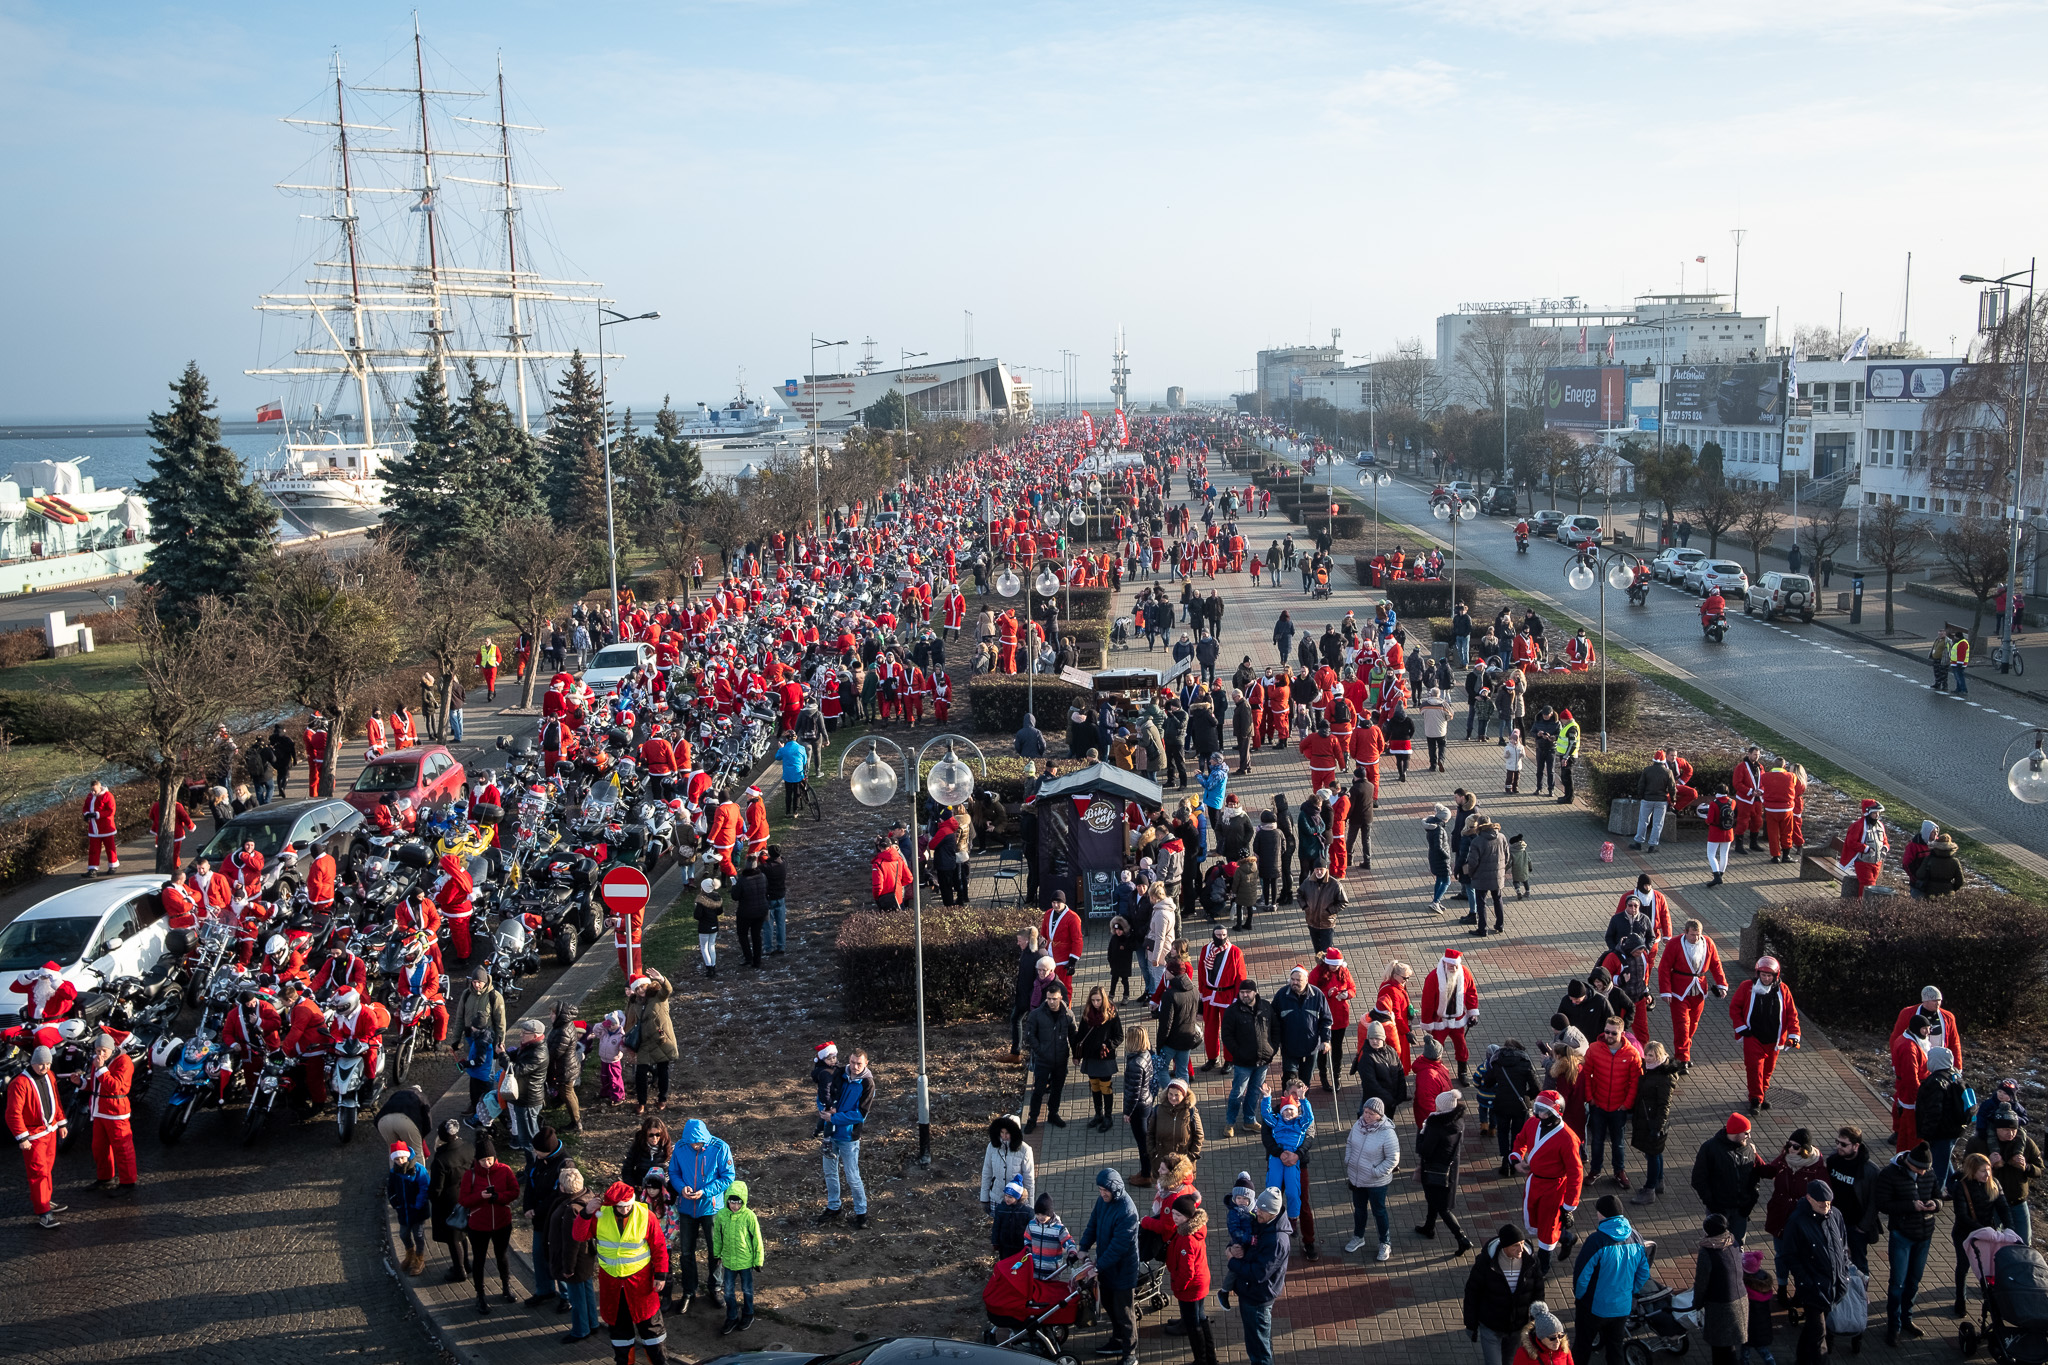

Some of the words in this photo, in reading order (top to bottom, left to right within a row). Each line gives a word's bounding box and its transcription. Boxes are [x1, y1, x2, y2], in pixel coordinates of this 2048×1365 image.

[1459, 302, 1528, 312] UNIWERSYTET
[1540, 300, 1581, 310] MORSKI
[1564, 385, 1597, 408] Energa
[1681, 411, 1692, 420] 575
[1759, 412, 1774, 422] Jeep
[1083, 807, 1108, 820] Bike
